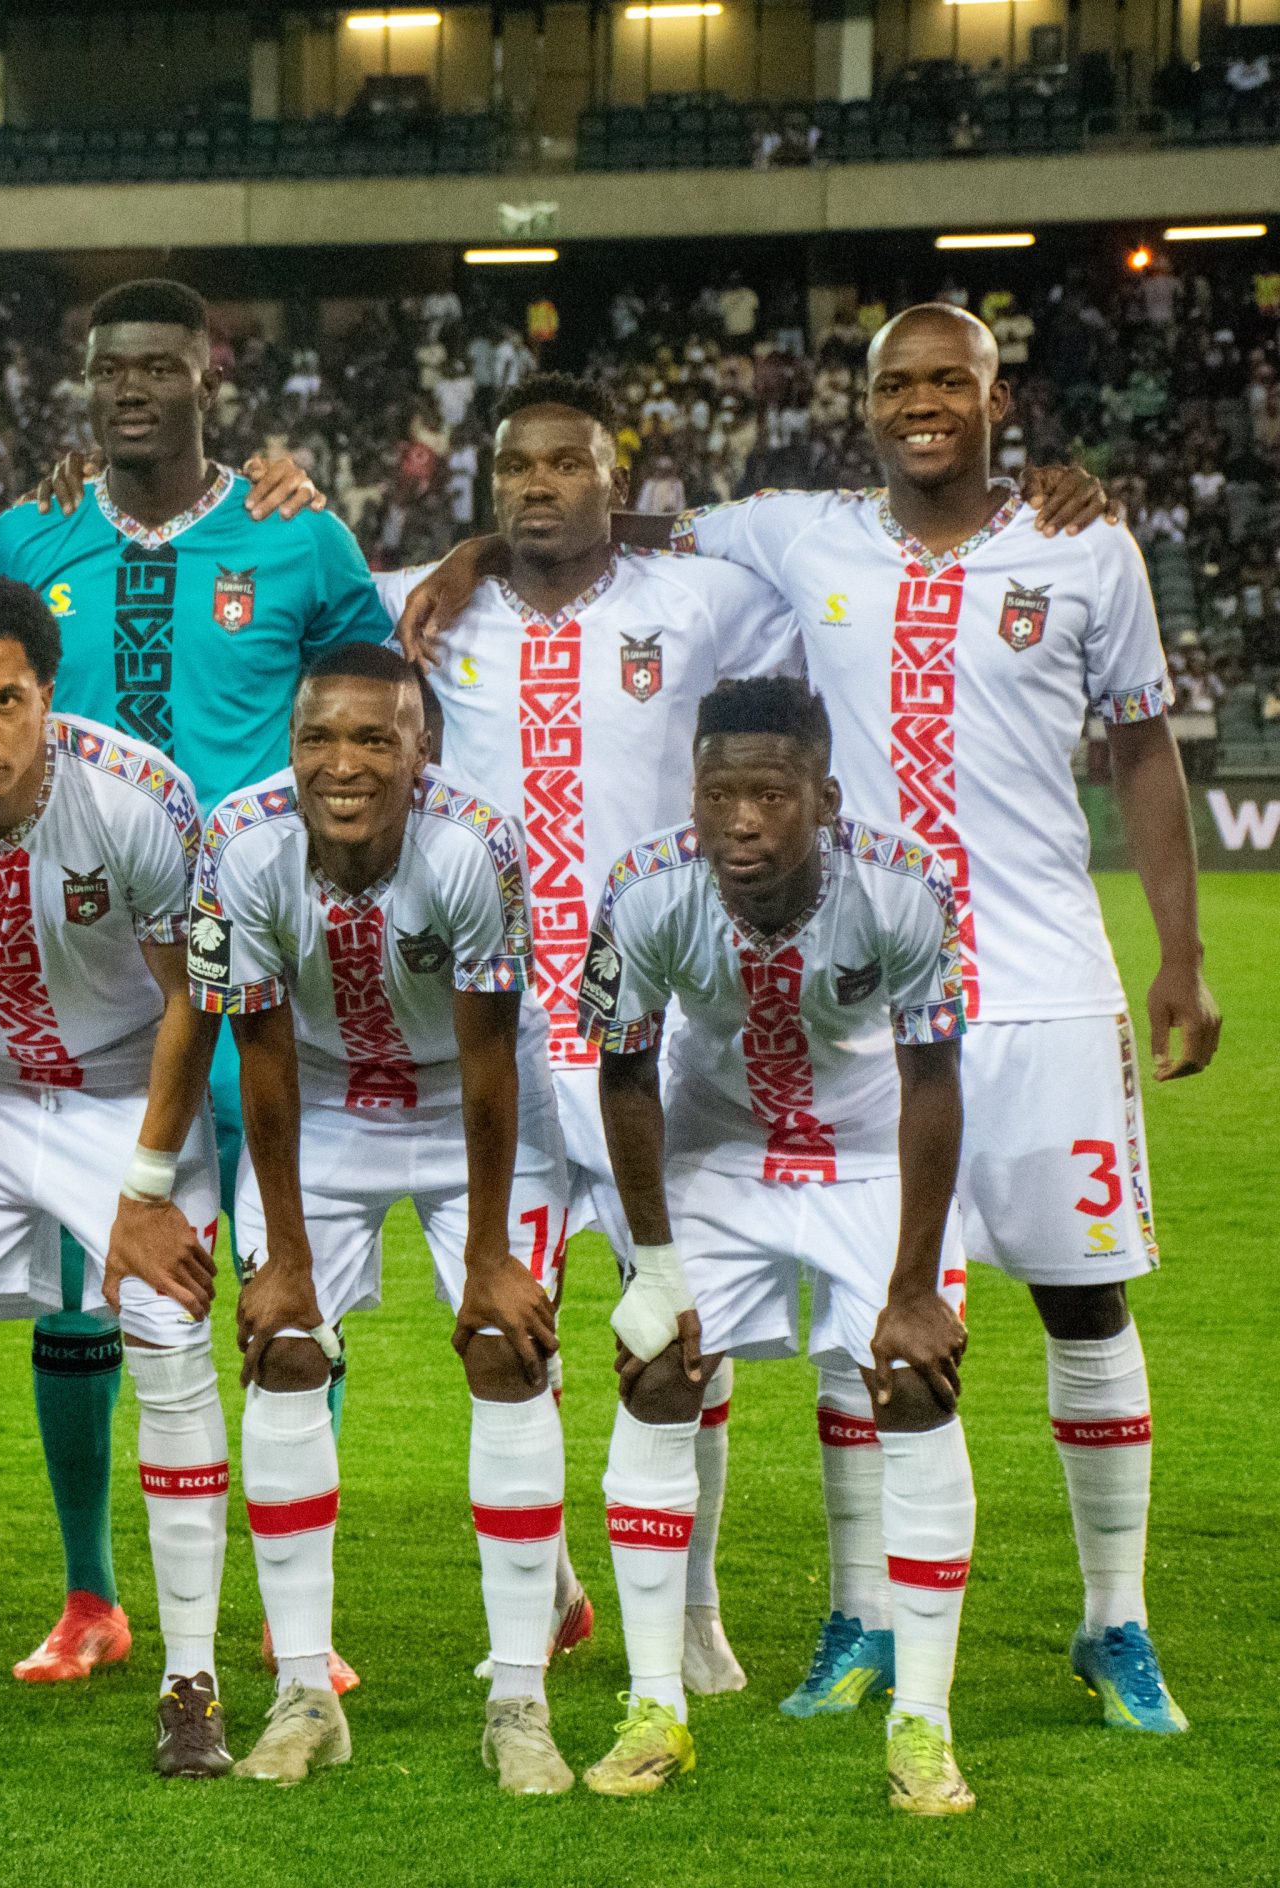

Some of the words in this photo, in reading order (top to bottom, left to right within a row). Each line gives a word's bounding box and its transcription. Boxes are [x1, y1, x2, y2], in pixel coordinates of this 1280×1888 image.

[1071, 1139, 1122, 1217] 3
[144, 1473, 172, 1488] THE
[611, 1517, 684, 1539] ROCKETS
